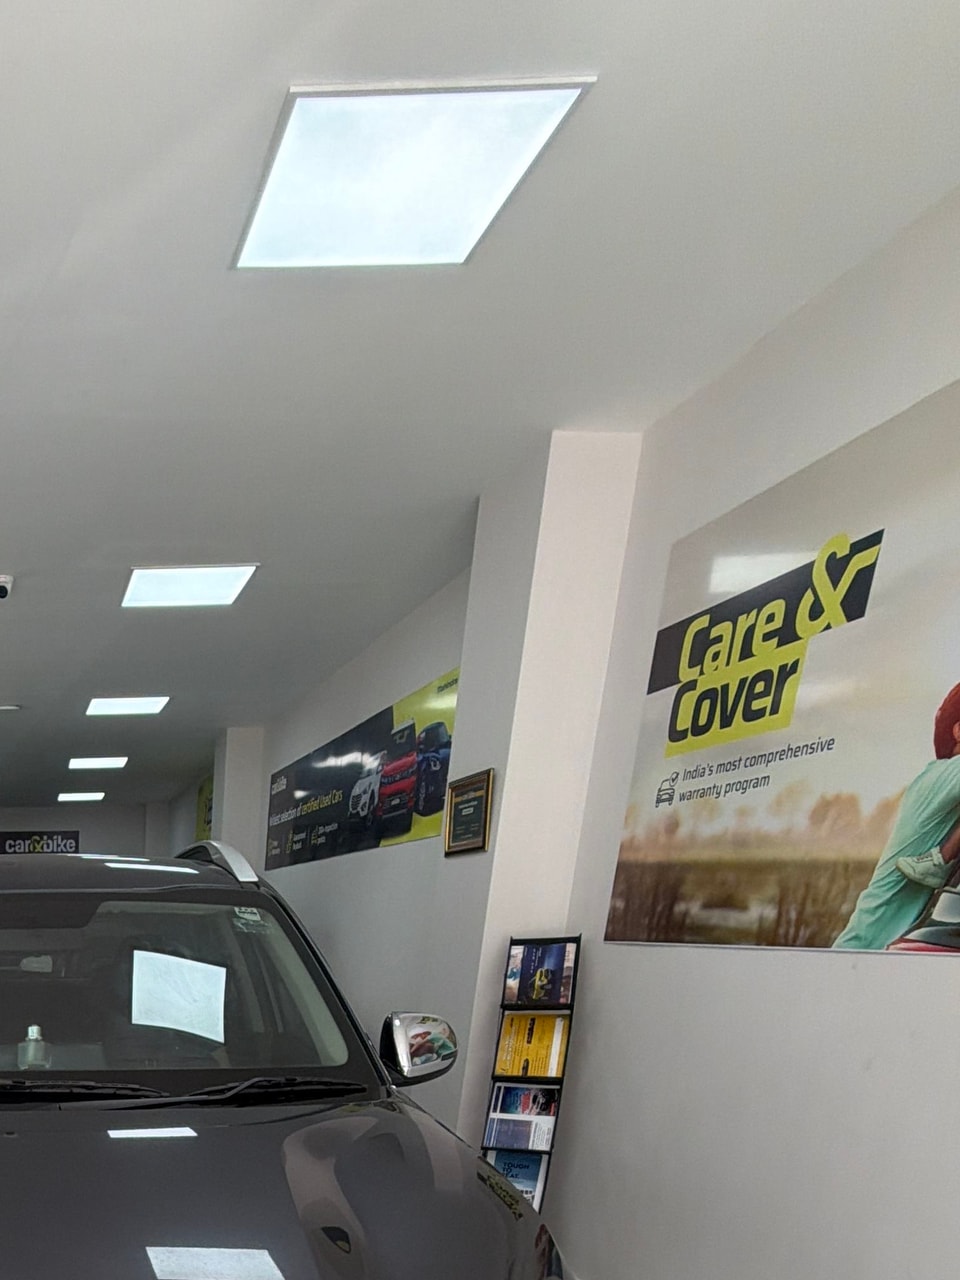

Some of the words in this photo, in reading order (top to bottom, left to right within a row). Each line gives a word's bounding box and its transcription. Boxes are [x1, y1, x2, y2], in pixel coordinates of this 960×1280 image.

[678, 598, 786, 682] Care
[795, 531, 881, 639] &
[667, 658, 800, 743] Cover
[682, 762, 715, 781] India's
[716, 756, 743, 774] most
[744, 736, 836, 769] comprehensive
[678, 782, 723, 802] warranty
[724, 774, 771, 797] program
[5, 835, 77, 853] car&bike
